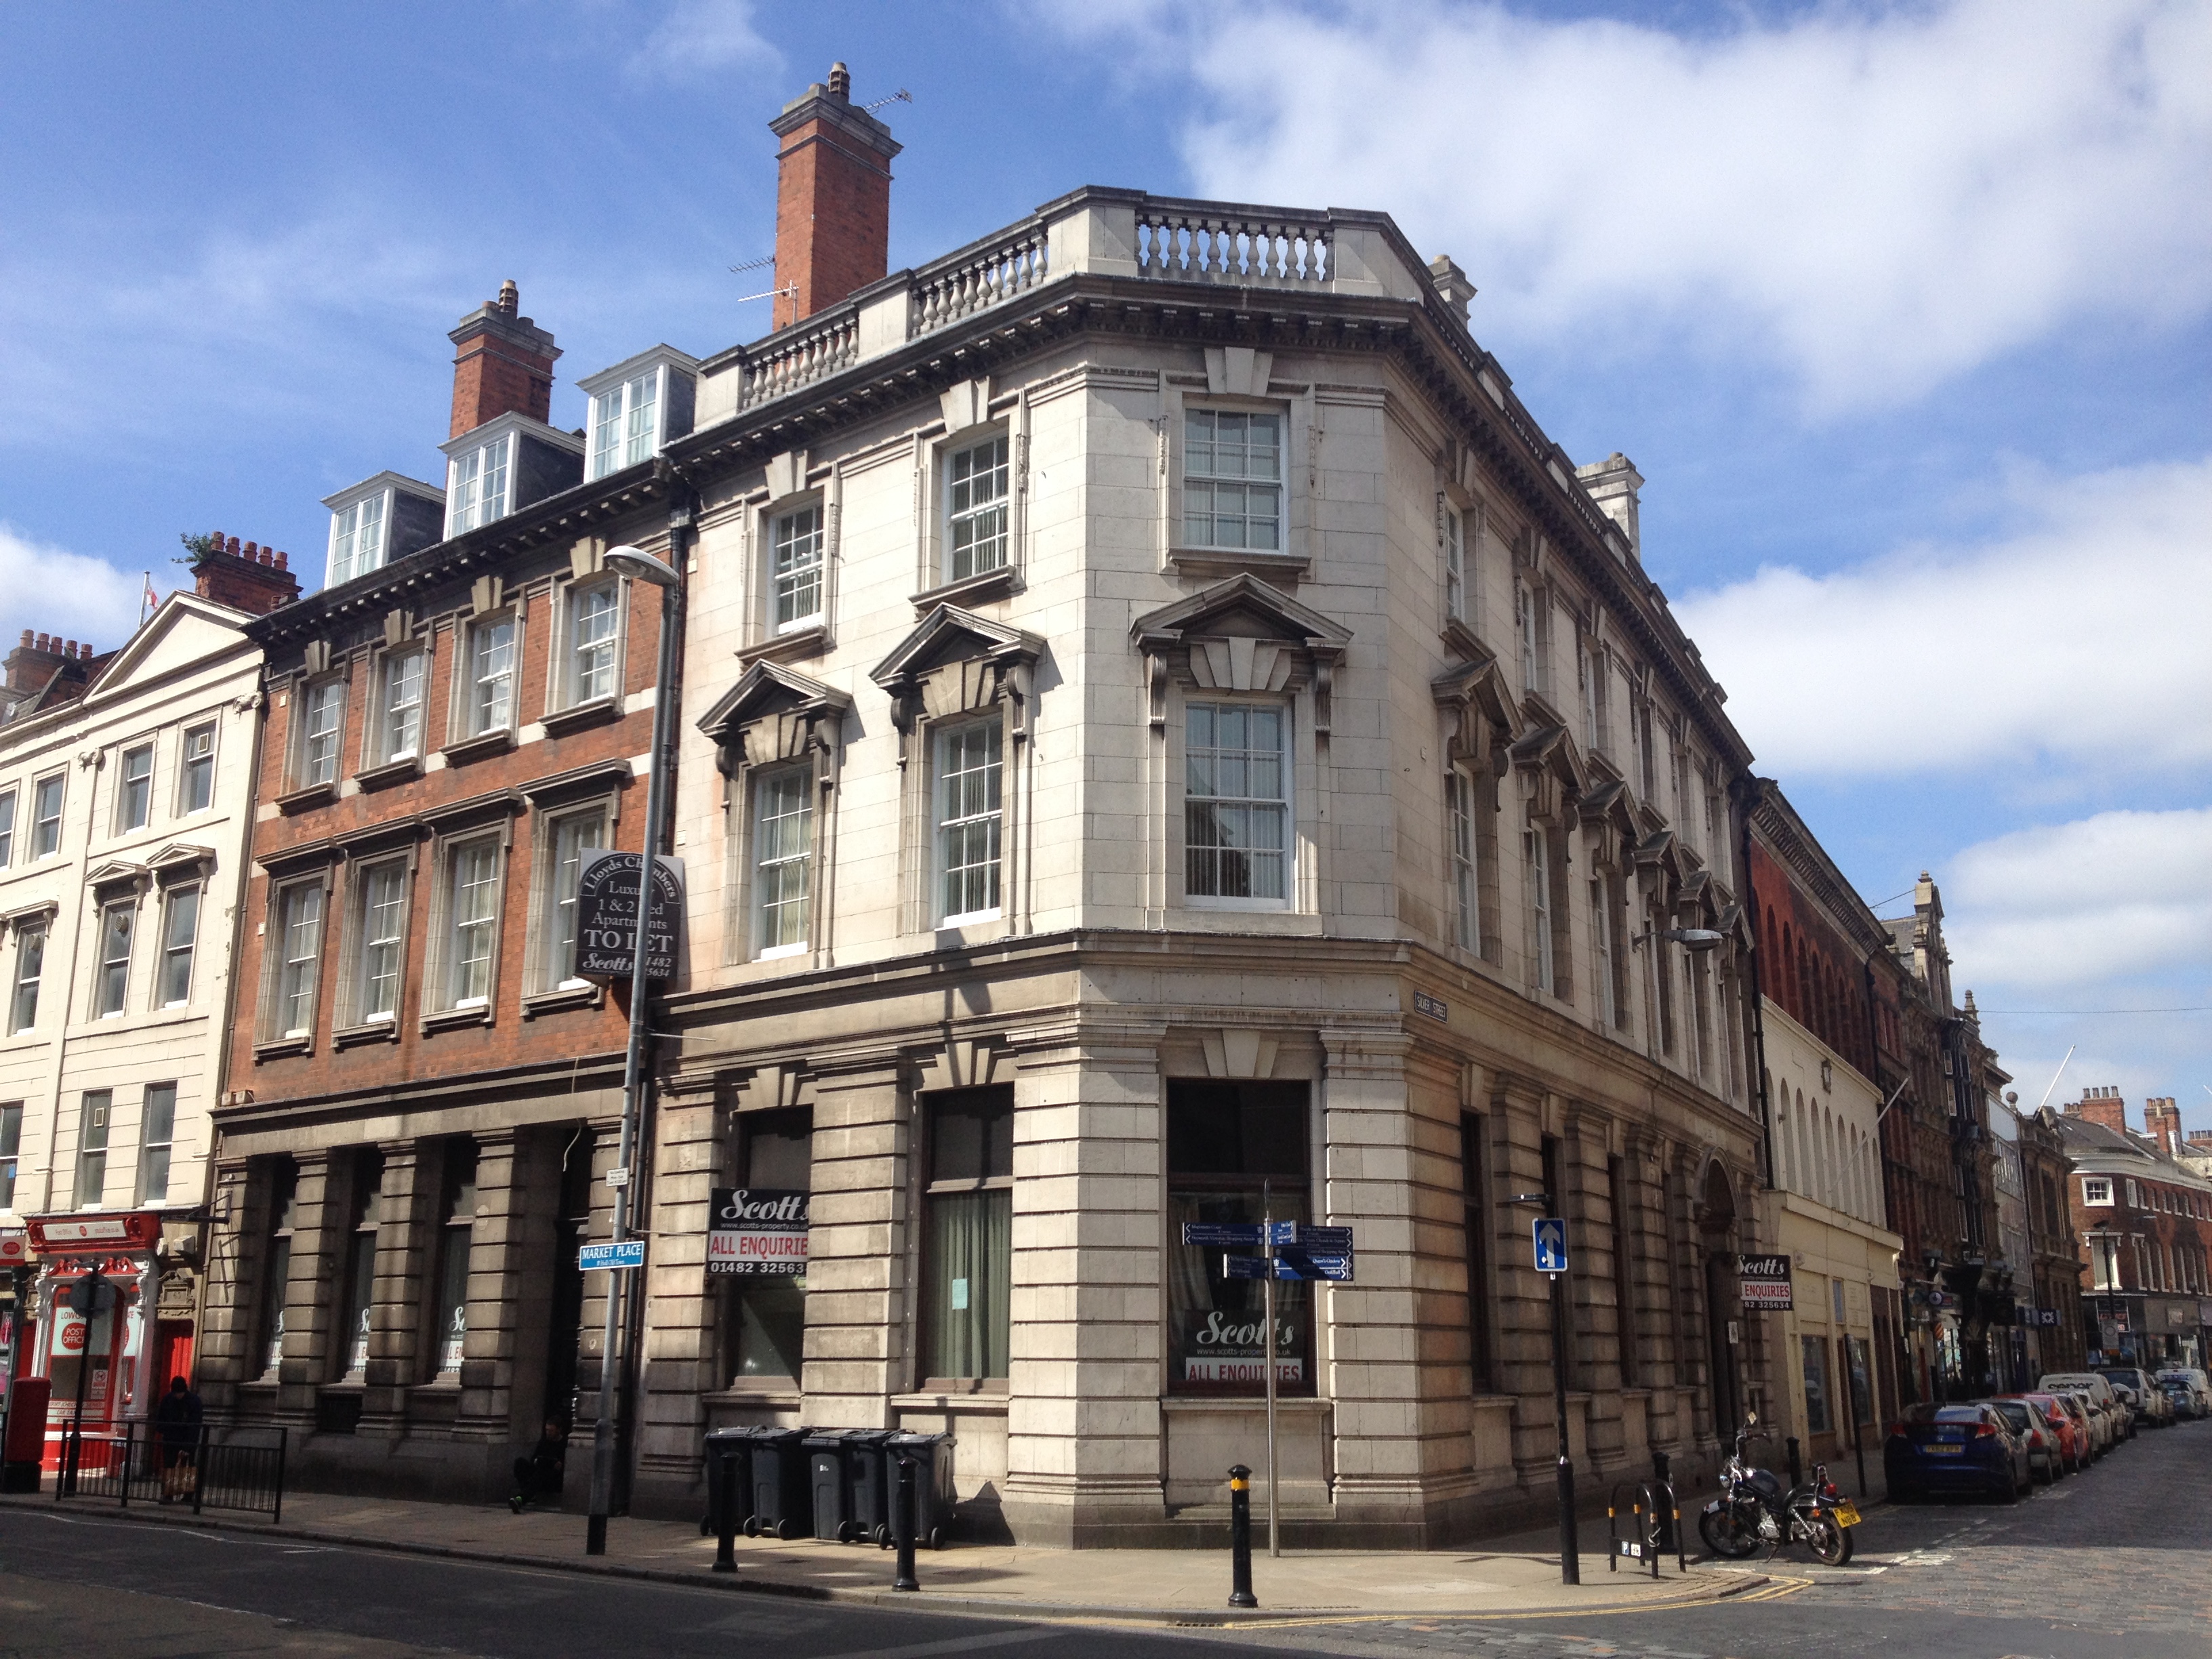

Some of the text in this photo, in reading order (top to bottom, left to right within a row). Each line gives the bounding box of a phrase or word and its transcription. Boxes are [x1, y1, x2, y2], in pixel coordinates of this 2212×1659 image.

[584, 857, 676, 899] Lloyds Chmbers
[609, 881, 655, 896] Luxu
[598, 899, 663, 915] 1 & 2 ed
[592, 912, 668, 929] Apartmnts
[583, 929, 674, 953] TO LET
[582, 952, 672, 971] Scotts 1482
[642, 968, 670, 977] 5634
[1417, 996, 1446, 1017] SILVER STREET
[720, 1189, 809, 1221] Scotts
[582, 1244, 641, 1259] MARKET PLACE
[711, 1236, 808, 1260] ALL ENQUIRIE
[711, 1262, 805, 1273] 01482 32563
[1738, 1254, 1784, 1275] Scotts
[1744, 1284, 1789, 1300] ENQUIRIES
[61, 1311, 83, 1319] LOWG
[1189, 1364, 1300, 1381] ALL ENQUIIES
